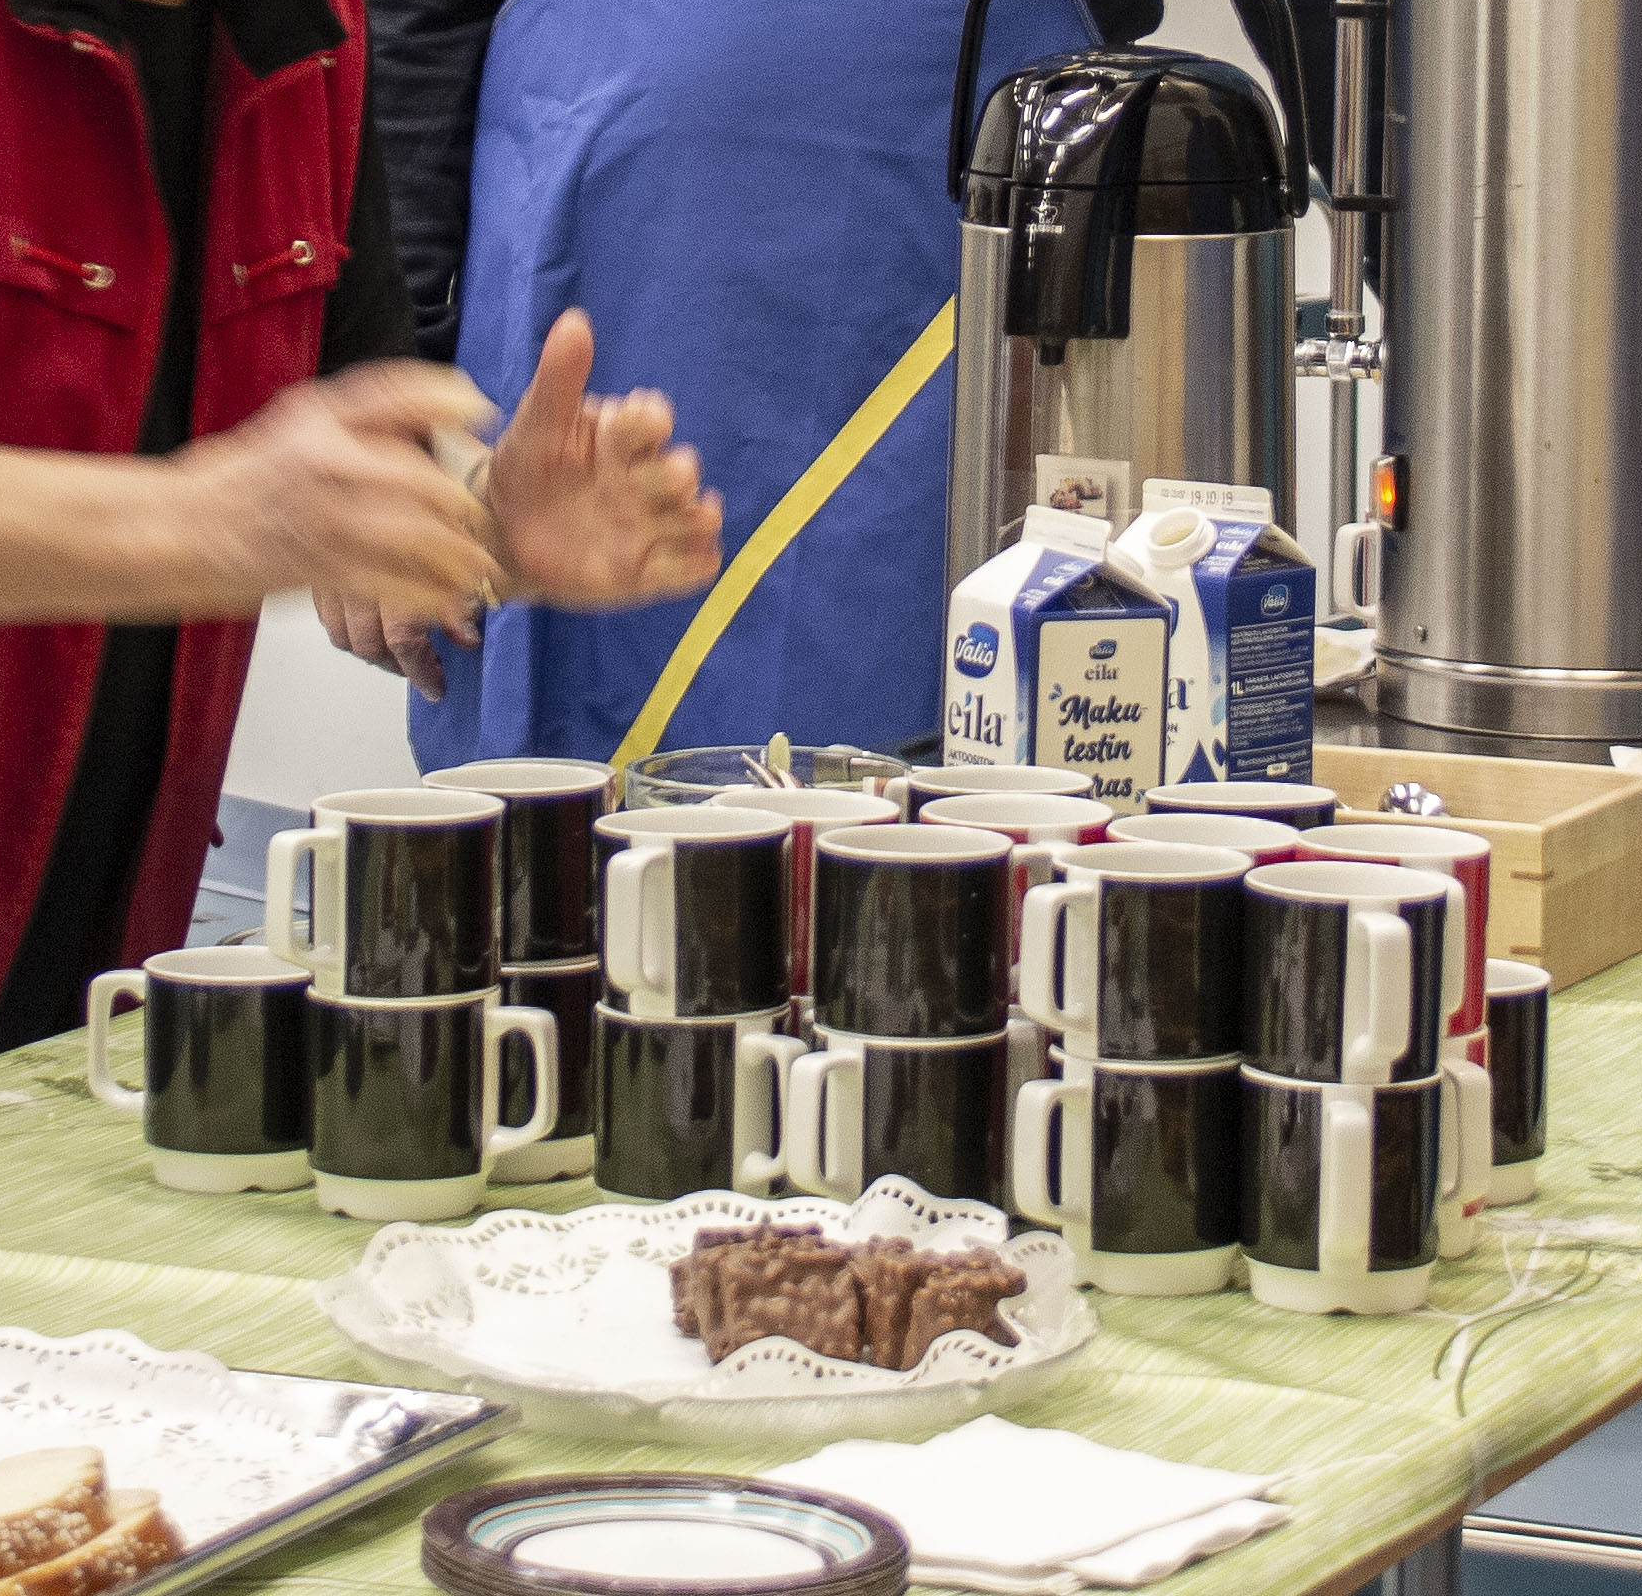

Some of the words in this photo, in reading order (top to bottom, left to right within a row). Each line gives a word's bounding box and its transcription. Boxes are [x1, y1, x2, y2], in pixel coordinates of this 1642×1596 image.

[956, 635, 994, 668] Valio
[948, 692, 1003, 747] eila
[1063, 732, 1132, 763] testin
[1092, 773, 1133, 797] ras
